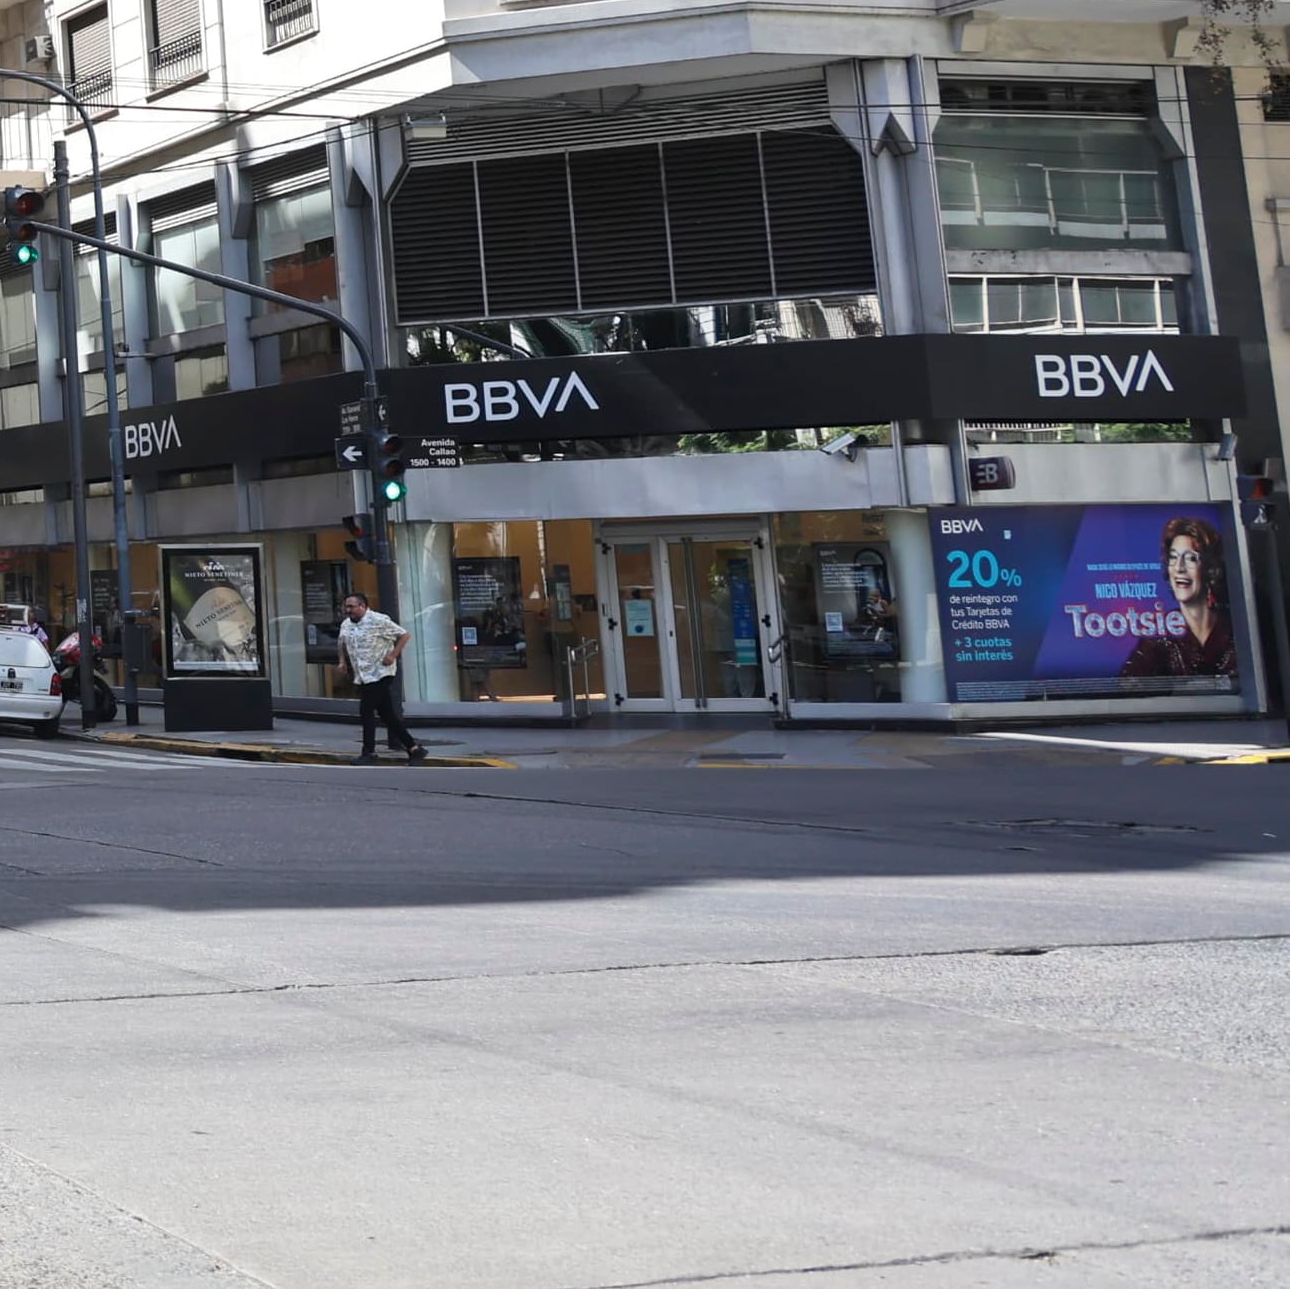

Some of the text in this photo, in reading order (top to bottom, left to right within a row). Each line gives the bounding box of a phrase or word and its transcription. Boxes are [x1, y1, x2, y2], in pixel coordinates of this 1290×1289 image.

[1034, 349, 1175, 398] BBVA
[444, 370, 600, 424] BBVA
[124, 414, 182, 460] BBVA
[421, 438, 455, 447] Avenida
[429, 448, 456, 456] Callao
[409, 458, 429, 466] 1500
[437, 457, 456, 466] 1400
[941, 518, 984, 534] BBVA
[946, 549, 1022, 588] 20%
[1094, 580, 1158, 600] NICO VÁZQUEZ
[949, 593, 1018, 605] de reintegro con
[950, 606, 1013, 618] tus Tarjetas de
[952, 618, 1010, 630] Crédito BBVA
[1064, 601, 1187, 638] Tootsie
[964, 637, 972, 647] 3
[975, 637, 1012, 647] cuotas
[956, 650, 1014, 661] sin interés
